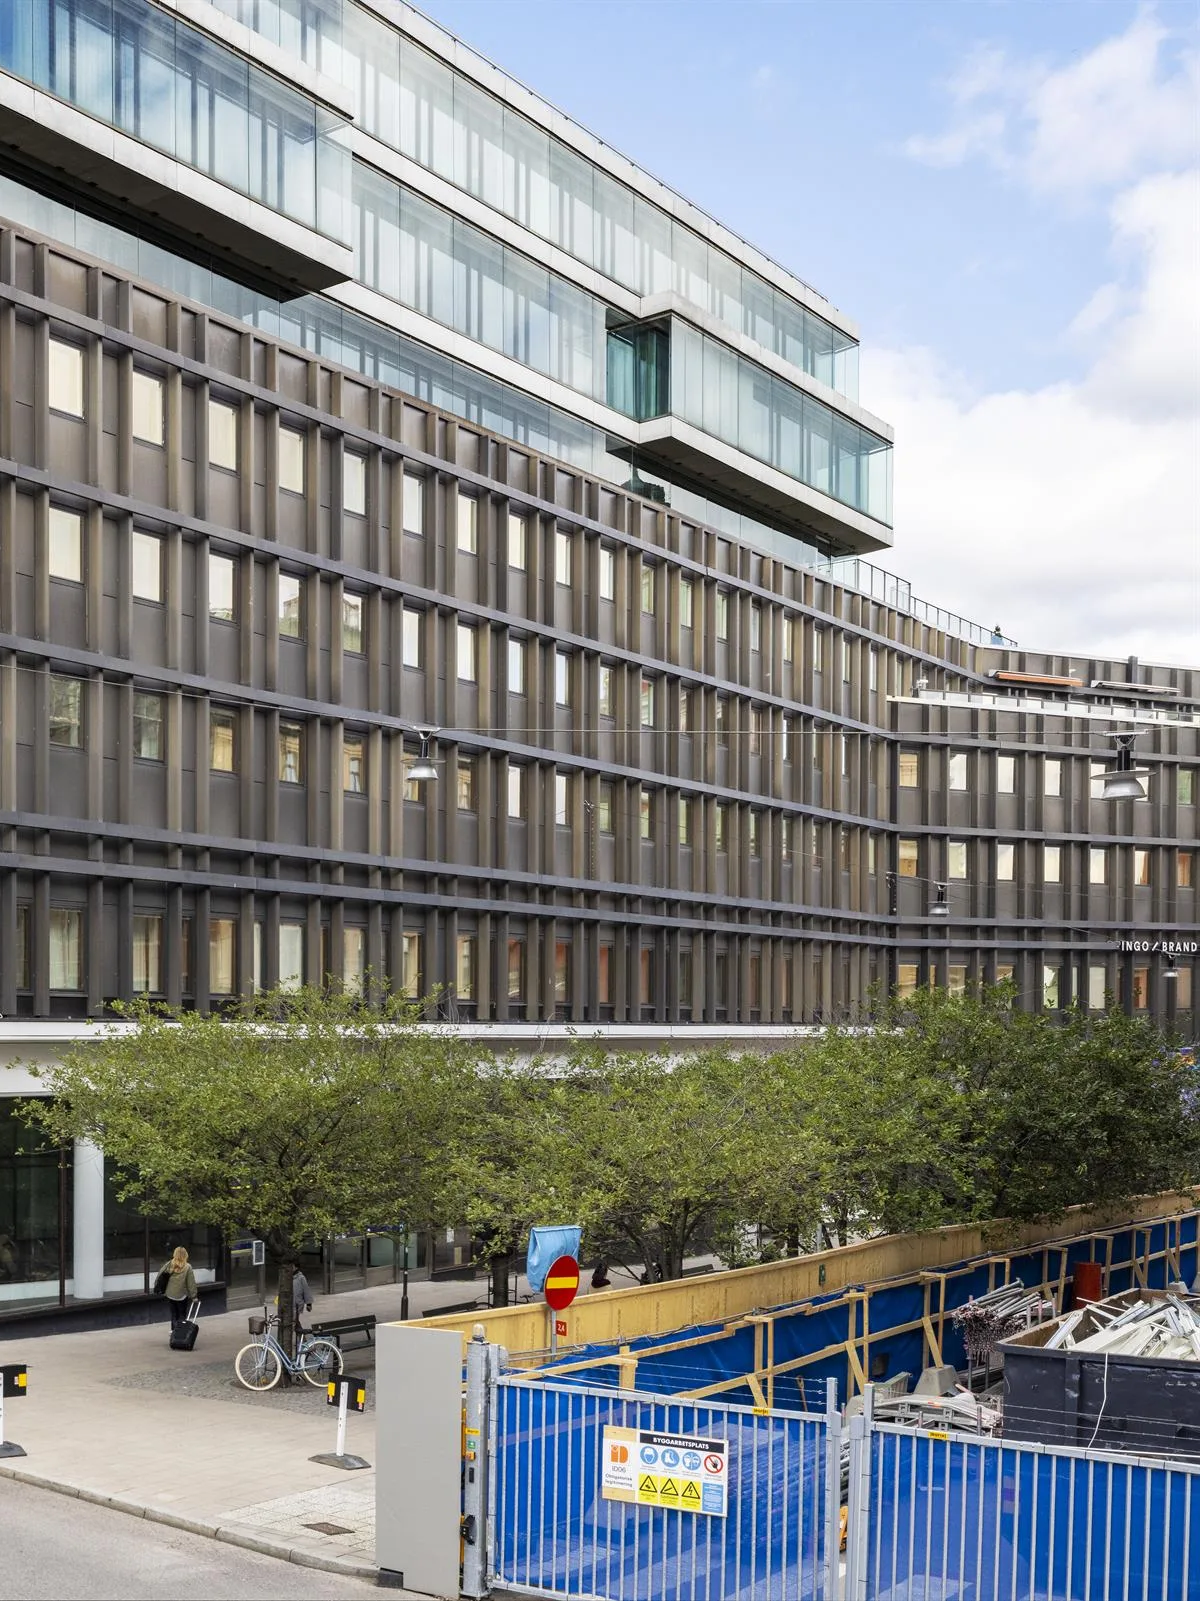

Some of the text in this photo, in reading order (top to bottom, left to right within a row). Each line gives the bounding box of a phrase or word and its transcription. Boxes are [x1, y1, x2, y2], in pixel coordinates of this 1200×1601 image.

[1121, 941, 1149, 951] INGO
[1162, 941, 1198, 952] BRAND
[653, 1437, 709, 1450] BYGGARBETSPLATS
